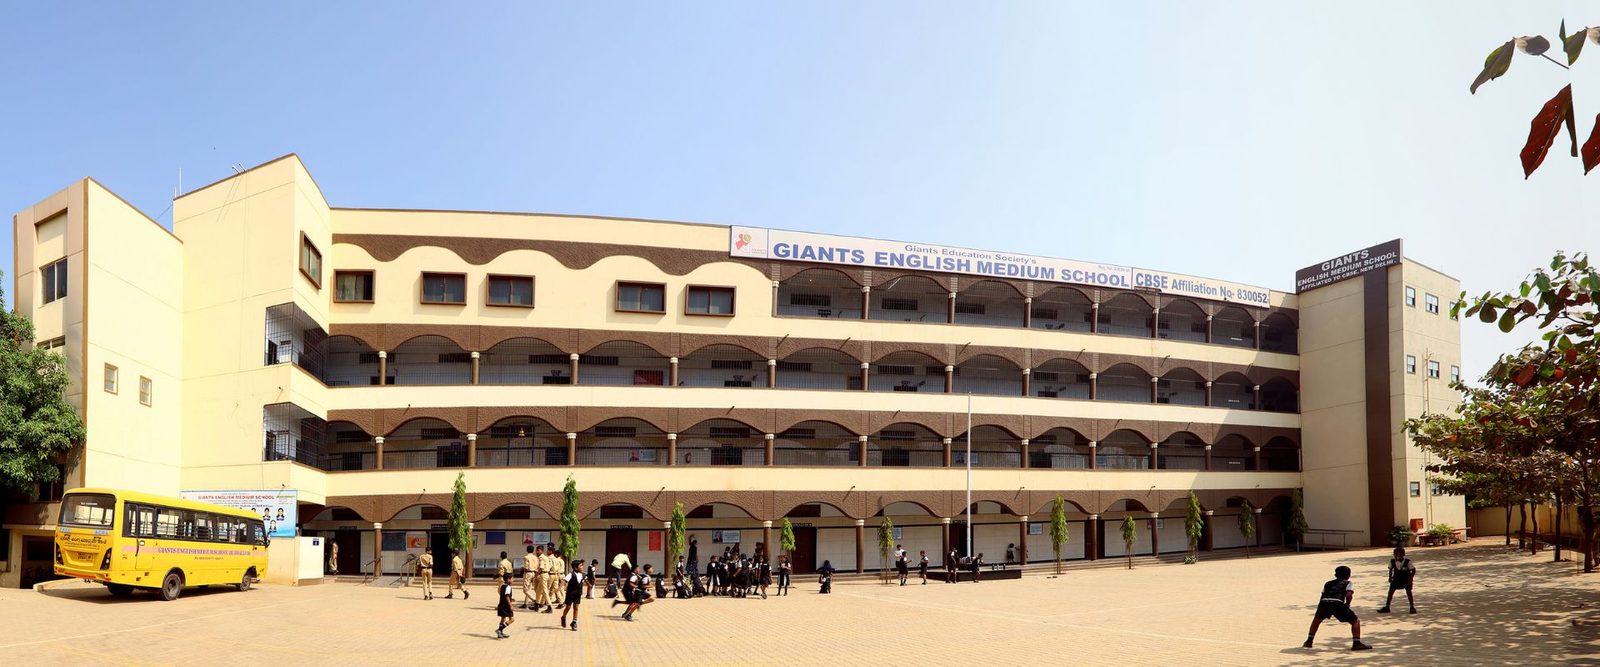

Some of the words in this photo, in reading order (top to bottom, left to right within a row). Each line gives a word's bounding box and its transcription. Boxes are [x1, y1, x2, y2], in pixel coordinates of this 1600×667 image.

[773, 242, 865, 264] GIANTS
[874, 251, 971, 273] ENGLISH
[977, 260, 1055, 280] MEDIUM
[1061, 269, 1130, 288] SCHOOL
[905, 245, 938, 254] Giants
[942, 249, 991, 260] Education
[995, 253, 1036, 265] Society's
[1297, 272, 1329, 287] ENGLISH
[1331, 261, 1362, 276] MEDIUM
[1364, 251, 1397, 266] SCHOOL
[1321, 250, 1369, 271] GIANTS
[1136, 272, 1168, 289] CBSE
[1171, 279, 1217, 297] Affiliation
[1237, 288, 1268, 304] 830052
[1301, 278, 1332, 291] AFFILIATED
[1360, 264, 1374, 273] NEW
